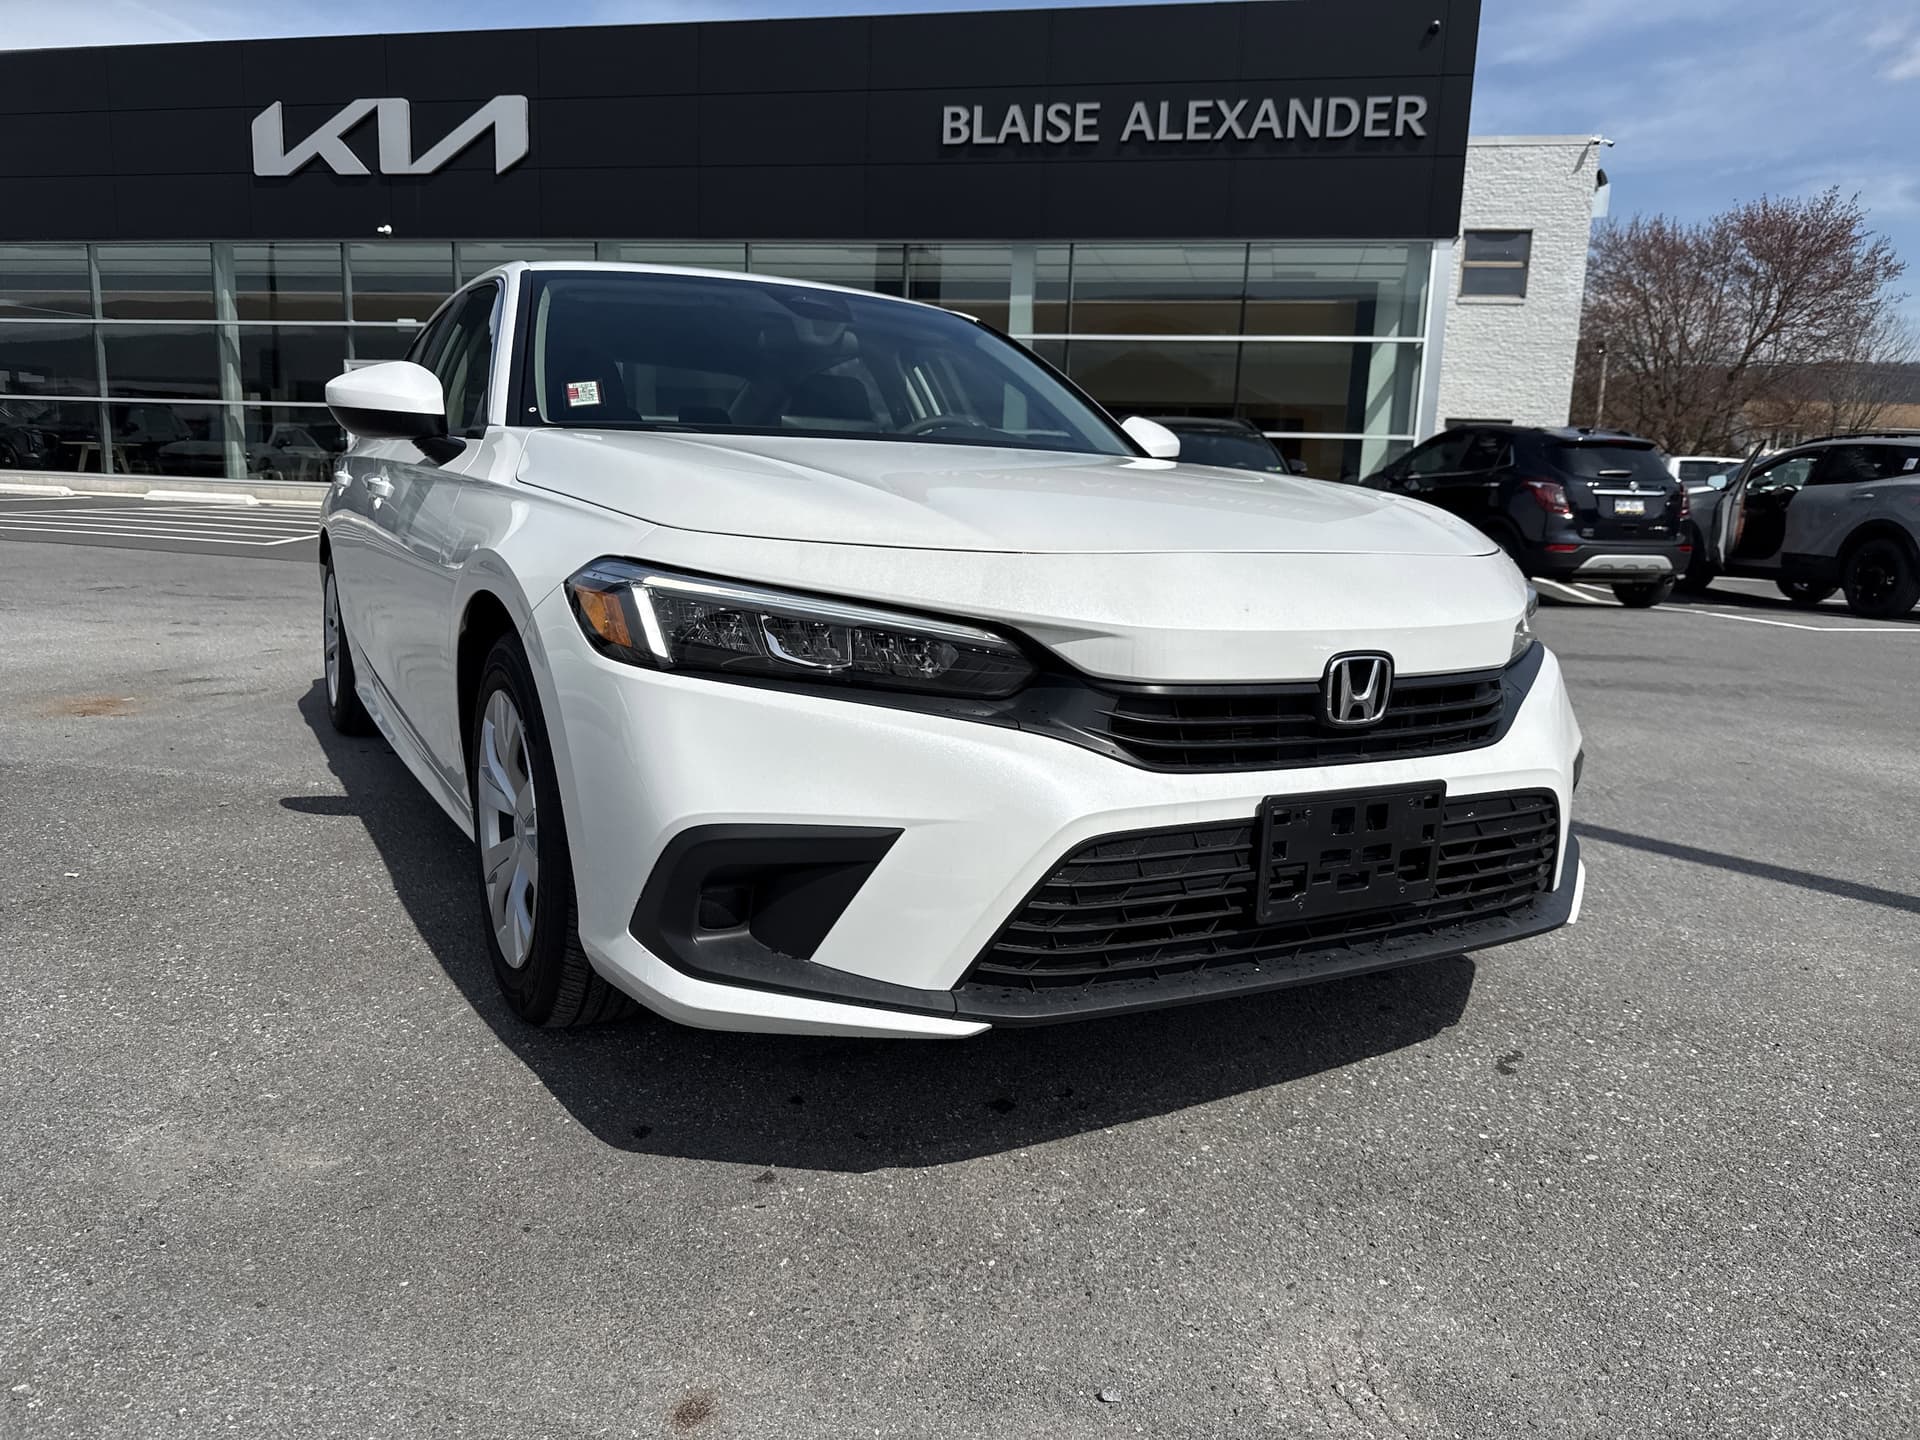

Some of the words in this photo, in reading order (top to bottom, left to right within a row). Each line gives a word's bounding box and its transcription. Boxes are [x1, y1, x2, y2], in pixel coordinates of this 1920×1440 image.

[251, 94, 529, 176] KIA
[942, 102, 1101, 145] BLAISE
[1120, 95, 1428, 142] ALEXANDER
